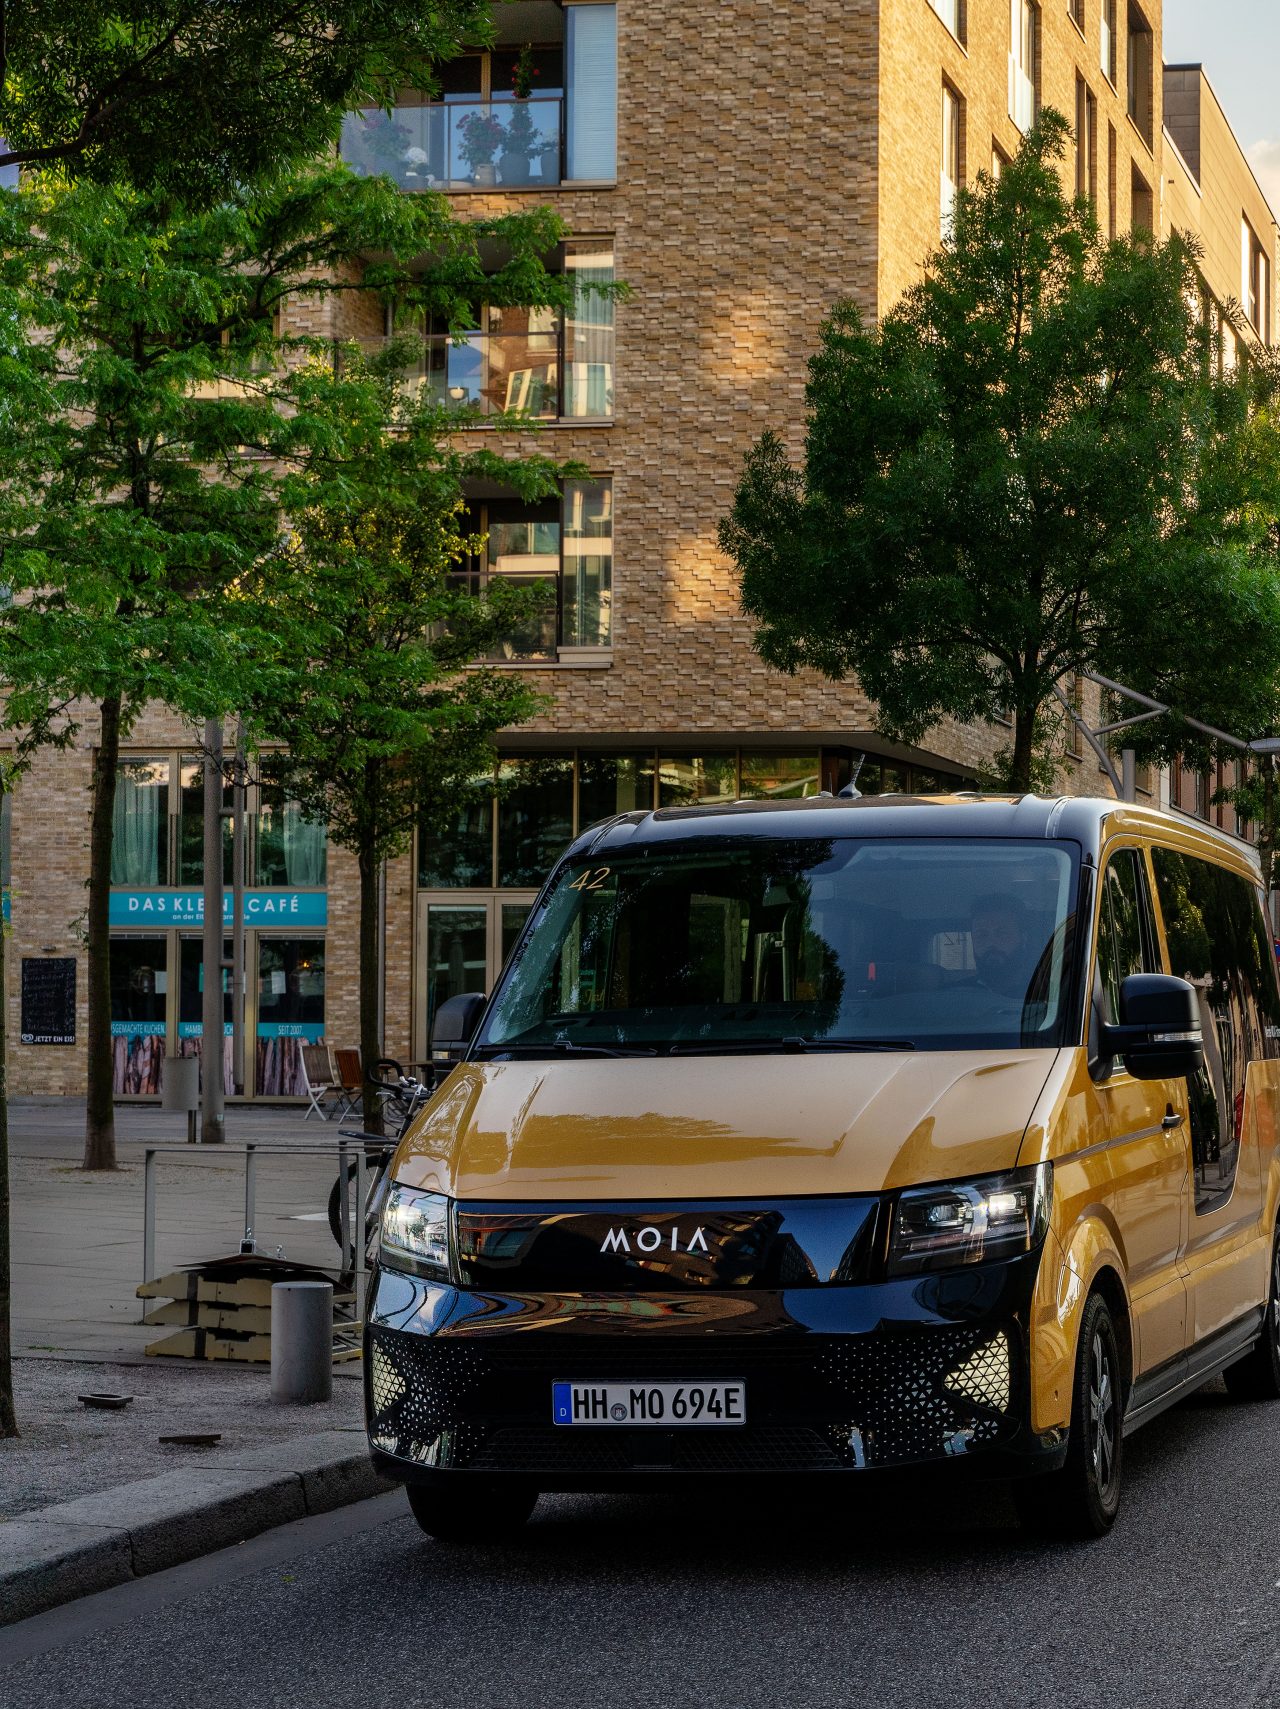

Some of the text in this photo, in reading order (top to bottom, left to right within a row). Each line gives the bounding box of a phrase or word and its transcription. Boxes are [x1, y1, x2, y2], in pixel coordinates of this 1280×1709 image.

[569, 867, 611, 891] 42
[128, 897, 166, 911] DAS
[248, 895, 299, 912] CAFÉ
[278, 1025, 290, 1035] SEIT
[600, 1227, 709, 1252] MOIA
[560, 1387, 741, 1419] D HH MO 694E
